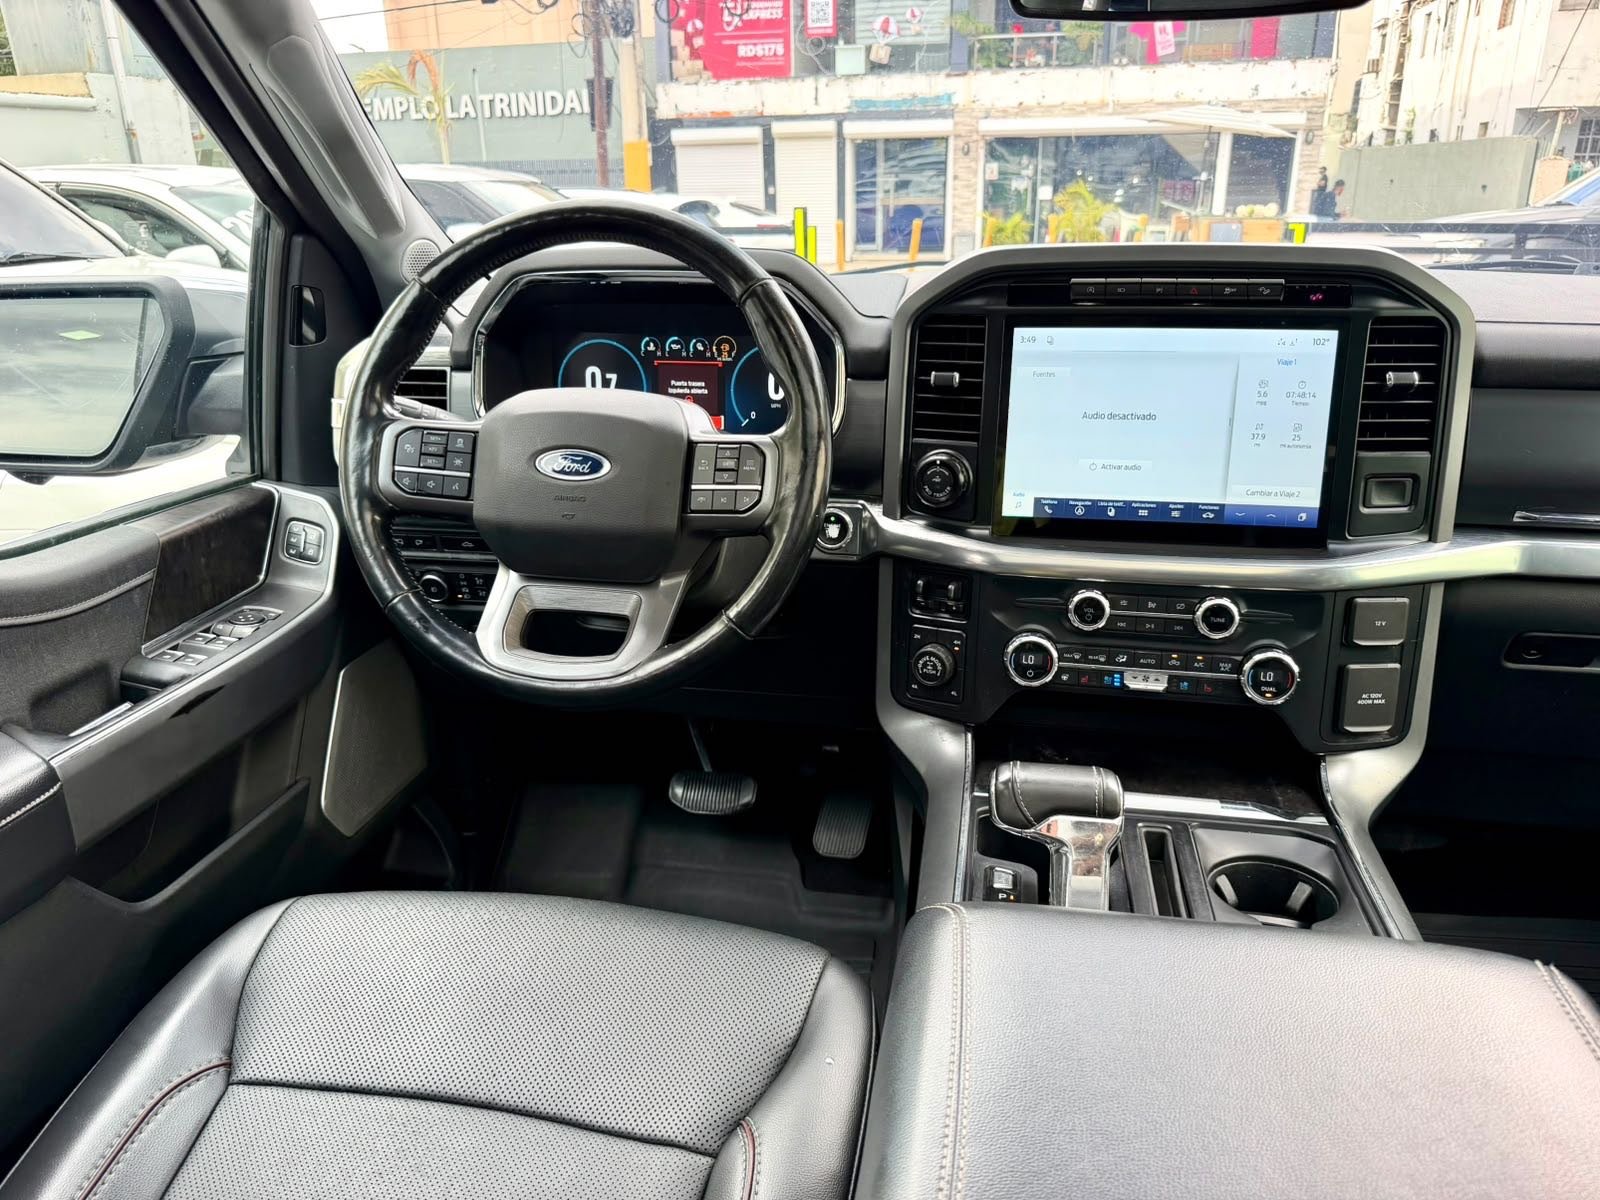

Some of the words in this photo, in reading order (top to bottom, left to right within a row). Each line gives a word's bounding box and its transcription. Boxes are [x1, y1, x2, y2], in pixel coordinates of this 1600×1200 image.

[445, 93, 477, 119] LA
[1019, 335, 1037, 344] 3:49
[1312, 337, 1330, 346] 102°
[1032, 370, 1056, 378] Fuentes
[670, 379, 688, 387] Puerta
[1256, 390, 1269, 398] 5.6
[1285, 391, 1317, 399] 07:48:14
[750, 411, 757, 419] 0
[1081, 410, 1106, 420] Audio
[1106, 411, 1157, 421] desactivado
[1250, 432, 1266, 440] 37.9
[1291, 433, 1302, 442] 25
[552, 455, 592, 474] Ford
[1100, 462, 1124, 471] Activar
[1123, 463, 1142, 471] audio
[1245, 488, 1274, 497] Cambiar
[1279, 490, 1296, 498] Viaje
[1022, 654, 1035, 665] LO
[1260, 671, 1274, 682] LO
